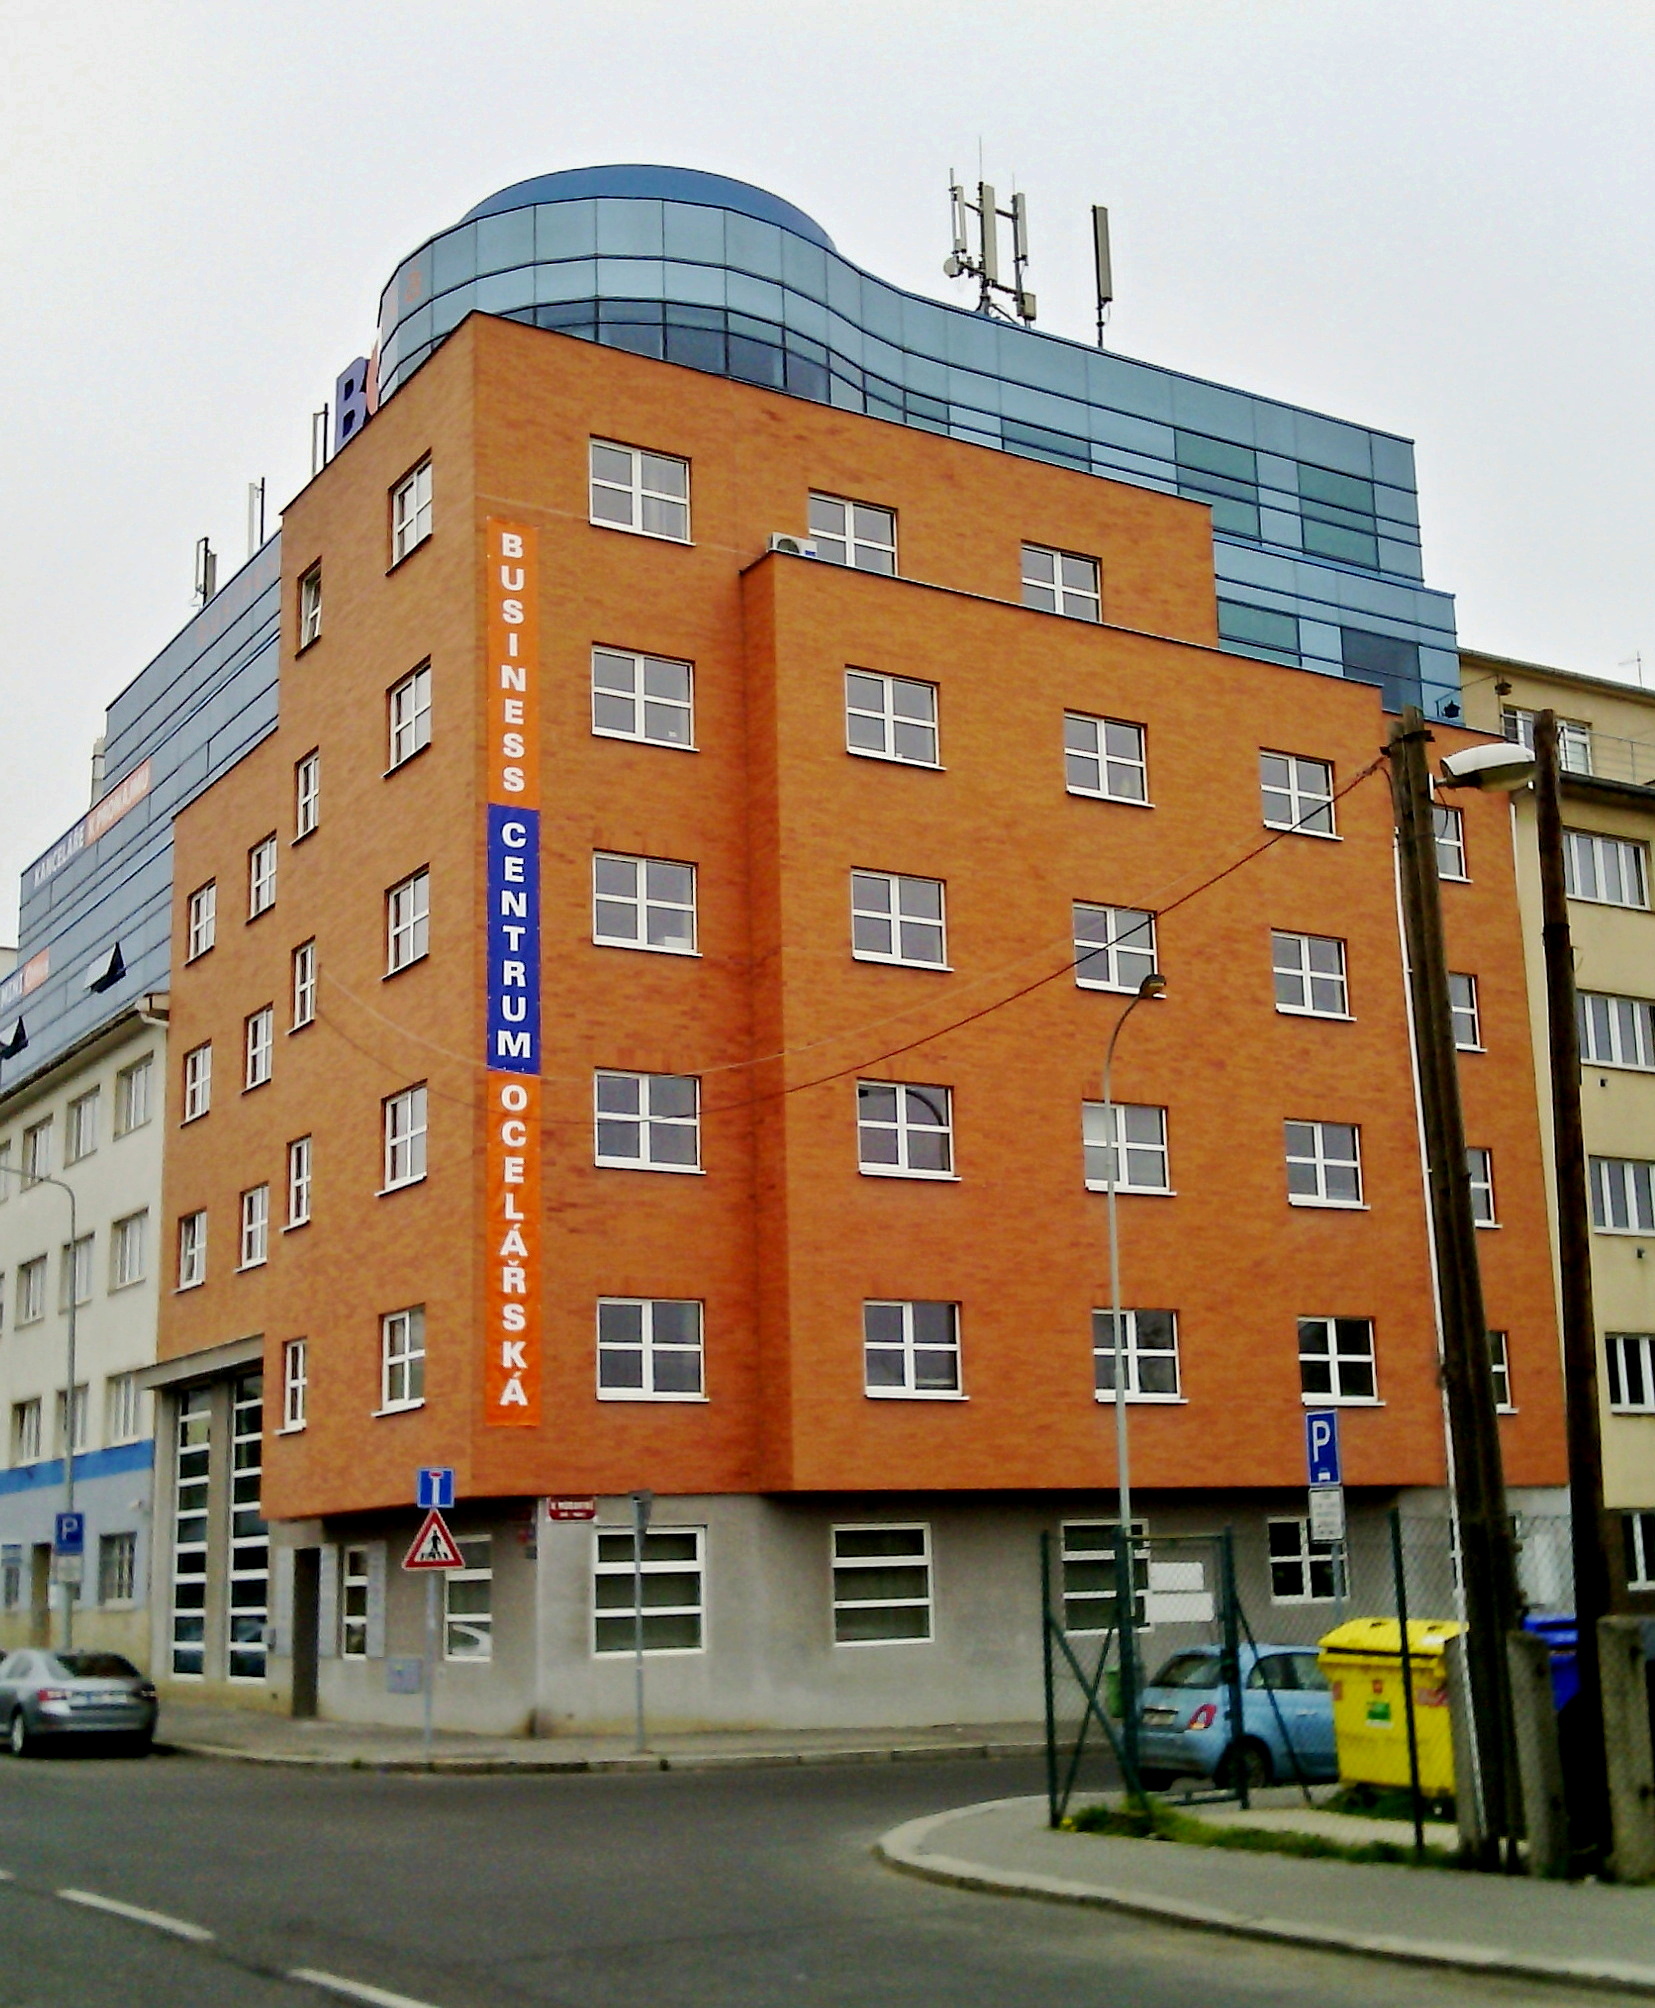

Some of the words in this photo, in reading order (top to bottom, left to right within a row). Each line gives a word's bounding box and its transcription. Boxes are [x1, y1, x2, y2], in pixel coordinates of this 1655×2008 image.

[501, 532, 526, 792] BUSINESS
[497, 822, 531, 1058] CENTRUM
[500, 1084, 528, 1406] OCELÁŘSKÁ
[61, 1516, 79, 1541] P
[1312, 1420, 1331, 1463] P
